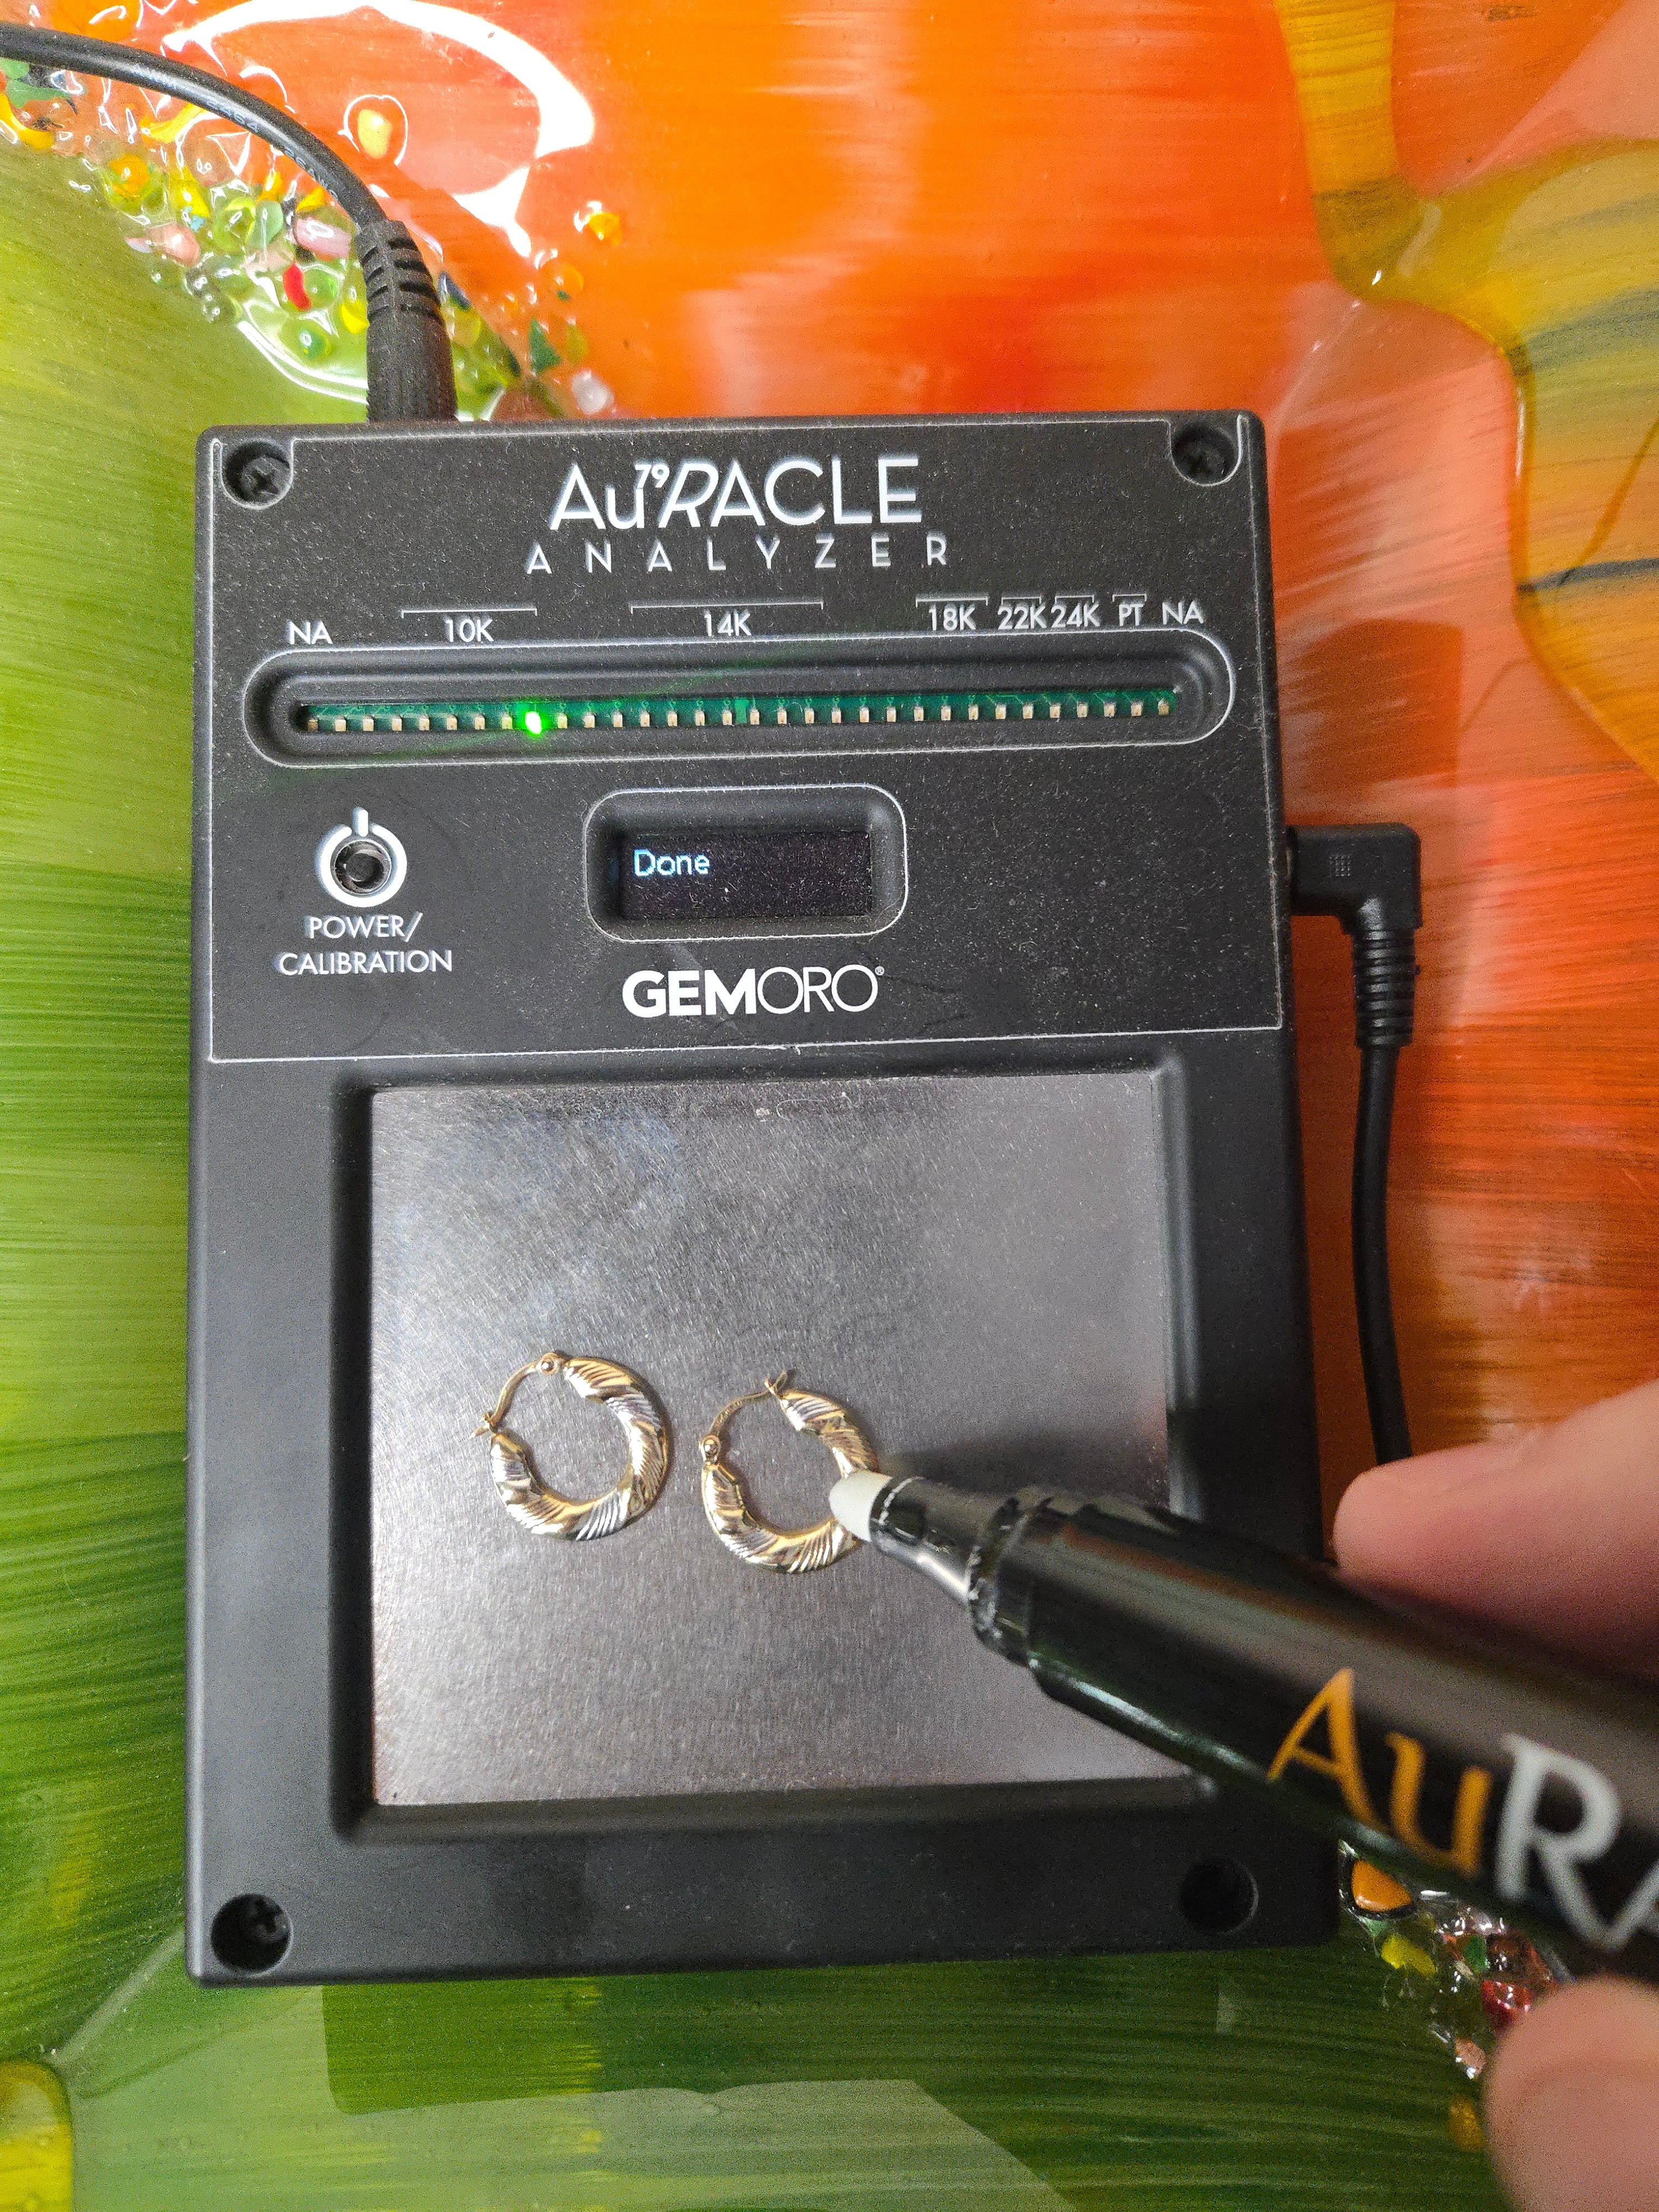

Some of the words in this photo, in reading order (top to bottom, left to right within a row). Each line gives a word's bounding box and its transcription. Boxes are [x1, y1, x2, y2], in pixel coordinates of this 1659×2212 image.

[526, 533, 947, 575] ANALYZER
[288, 619, 333, 645] NA
[445, 618, 494, 643] 10K
[705, 612, 752, 638] 14K
[928, 606, 978, 632] 18K
[997, 606, 1047, 631] 22K
[1051, 603, 1100, 629] 24K
[1119, 602, 1146, 627] PT
[1163, 601, 1204, 625] NA
[634, 849, 711, 877] Done
[307, 912, 424, 943] POWER/
[278, 949, 453, 976] CALIBRATION
